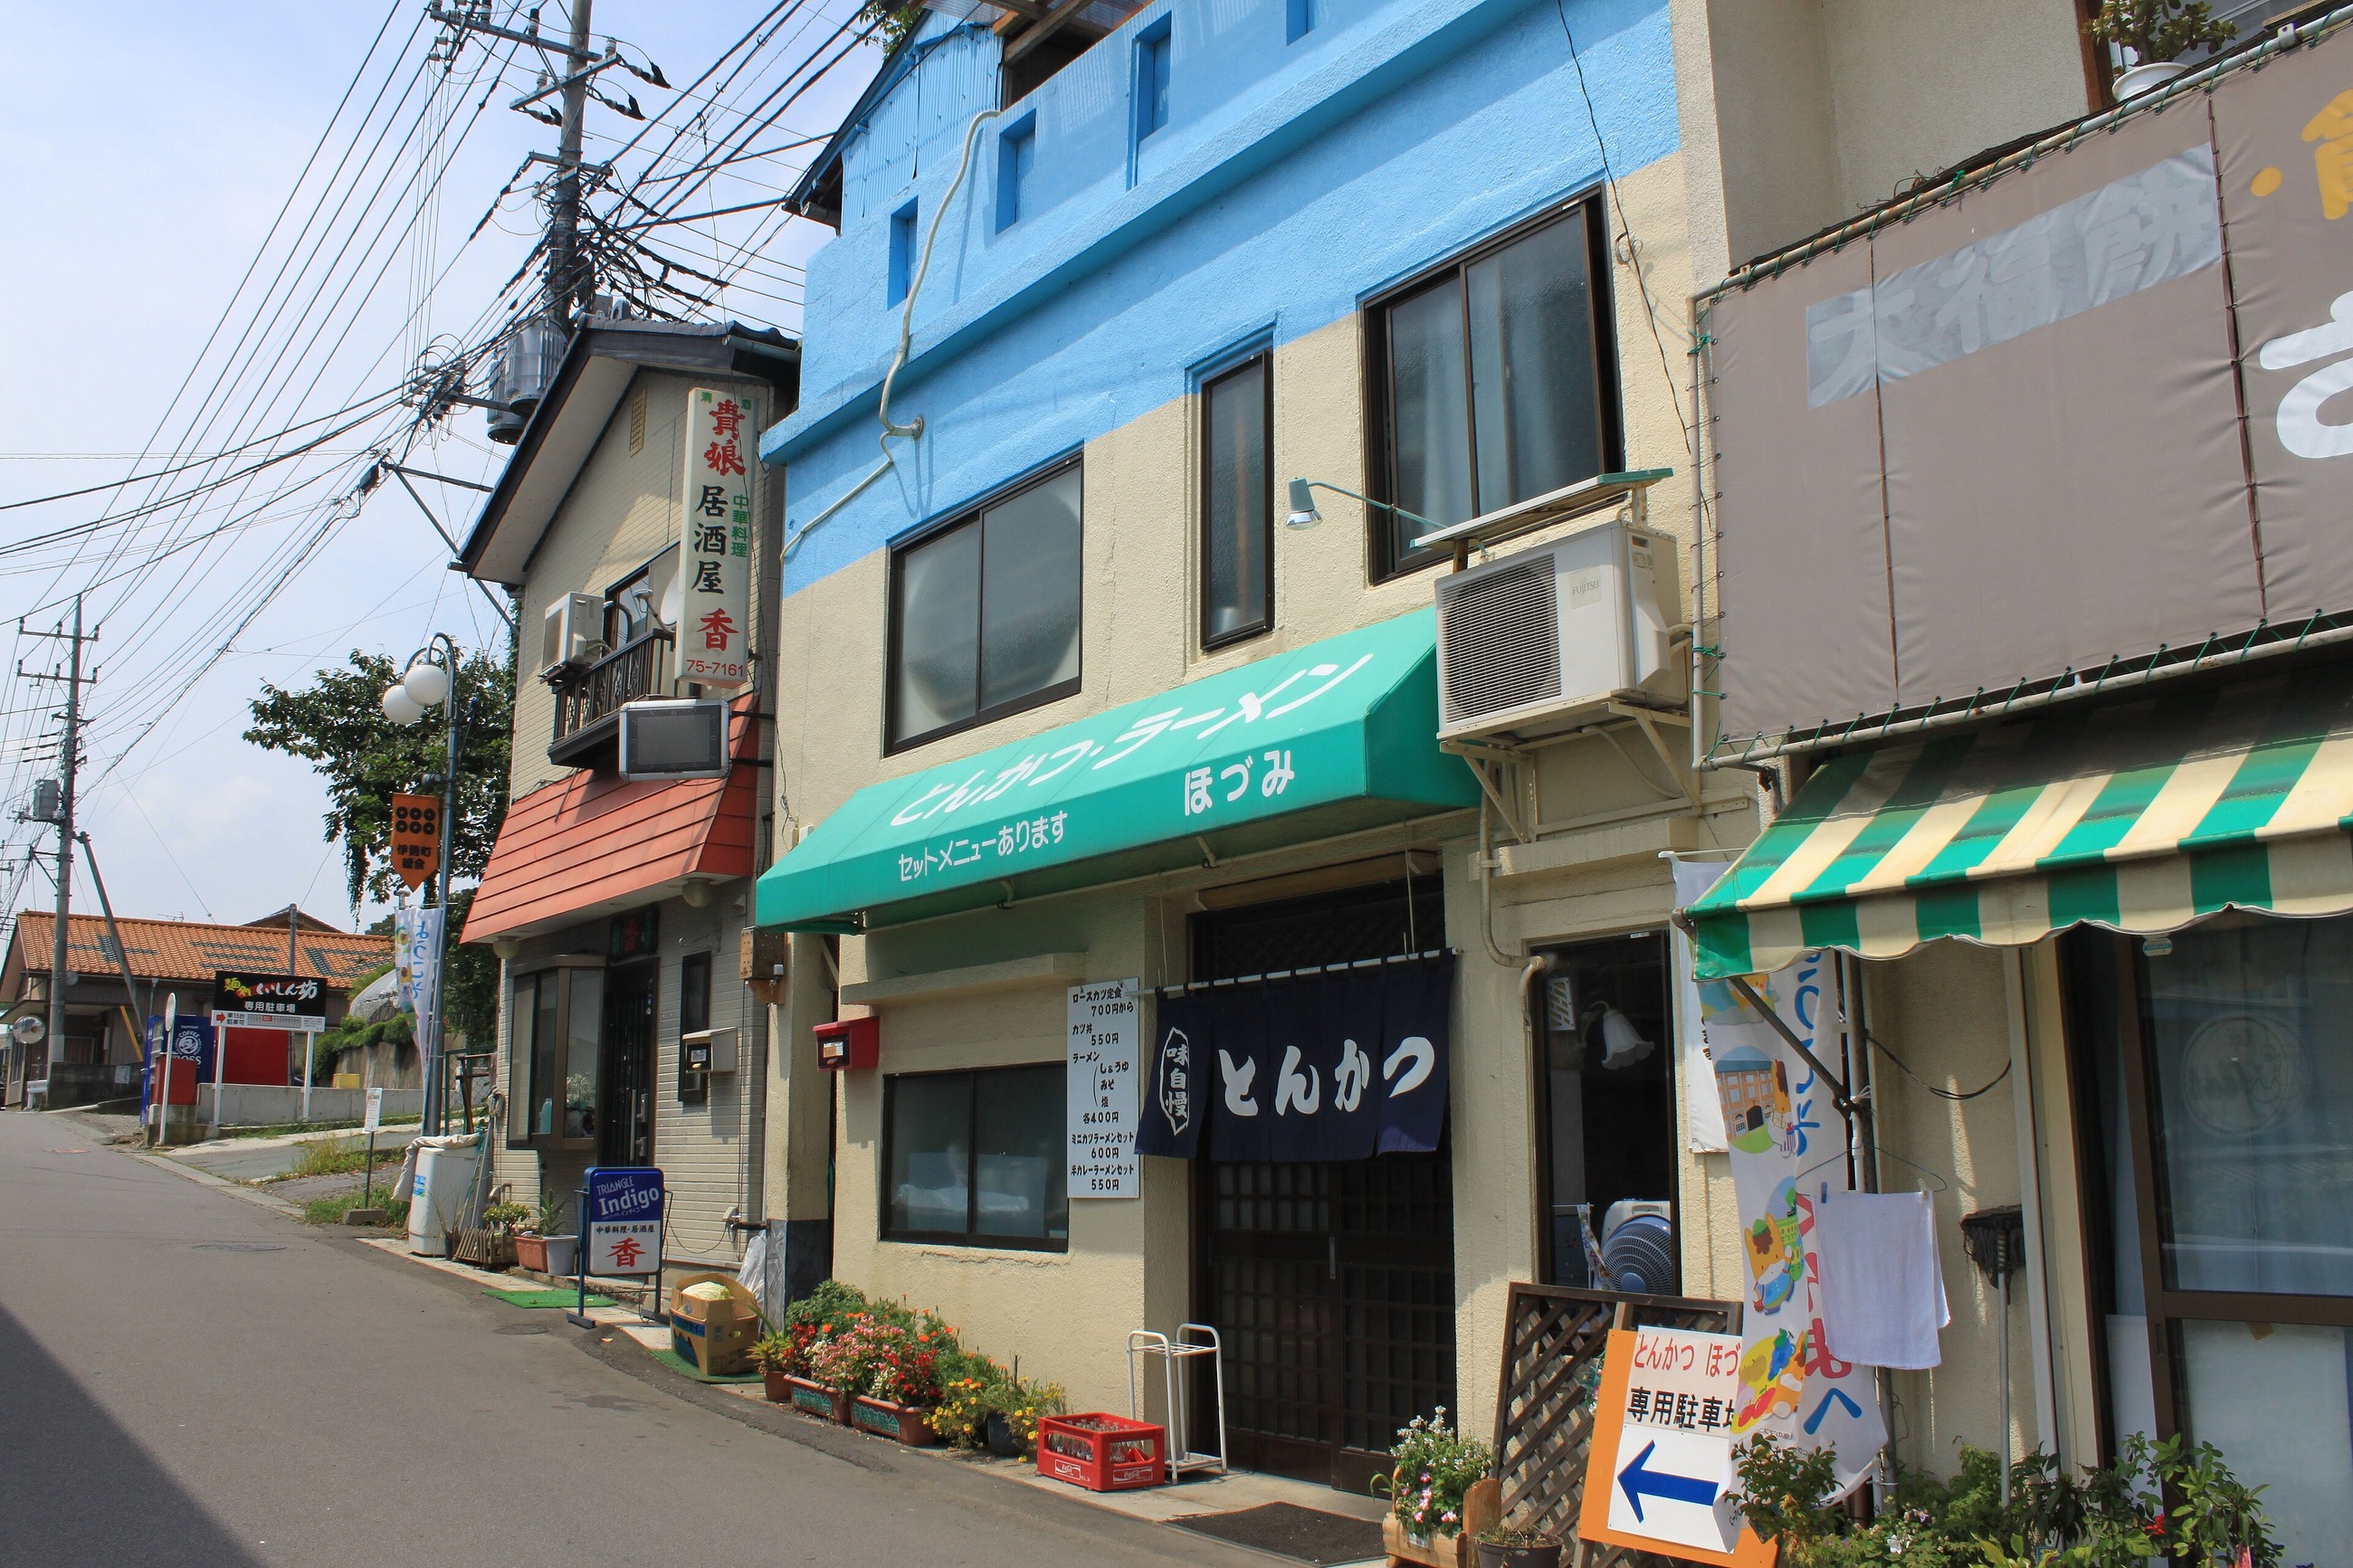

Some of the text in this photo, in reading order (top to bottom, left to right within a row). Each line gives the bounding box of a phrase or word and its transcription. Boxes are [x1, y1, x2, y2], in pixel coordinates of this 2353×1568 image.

[703, 398, 747, 477] 貴娘
[730, 493, 749, 559] 中華料理
[691, 484, 728, 595] 居酒屋
[1572, 579, 1599, 595] FUJITSU
[696, 607, 739, 652] 香
[686, 659, 745, 678] 75-7161
[1185, 749, 1295, 816] ほづみ
[899, 811, 1068, 882] セットメニューあります
[256, 980, 318, 1001] くいしん坊
[1072, 986, 1122, 1003] ロースカツ定食
[244, 1001, 296, 1013] 専用駐車場
[1091, 1002, 1134, 1017] 700円から
[178, 1030, 201, 1038] COFFEE
[1072, 1022, 1093, 1035] カツ丼
[1091, 1032, 1119, 1046] 550円
[1072, 1050, 1100, 1064] ラーメン
[1100, 1060, 1129, 1074] しょうゆ
[1100, 1079, 1115, 1091] みそ
[1166, 1044, 1188, 1118] 味自慢
[1218, 1036, 1435, 1117] とんかつ
[1101, 1096, 1110, 1107] 塩
[1082, 1111, 1119, 1124] 各400円
[1072, 1131, 1134, 1145] ミニカツラーメンセット
[1091, 1146, 1119, 1159] 600円
[596, 1175, 635, 1196] TRIANGLE
[1091, 1178, 1119, 1191] 550円
[598, 1186, 660, 1216] Indigo
[605, 1237, 646, 1268] 香
[1634, 1334, 1741, 1377] とんかつ ほづ
